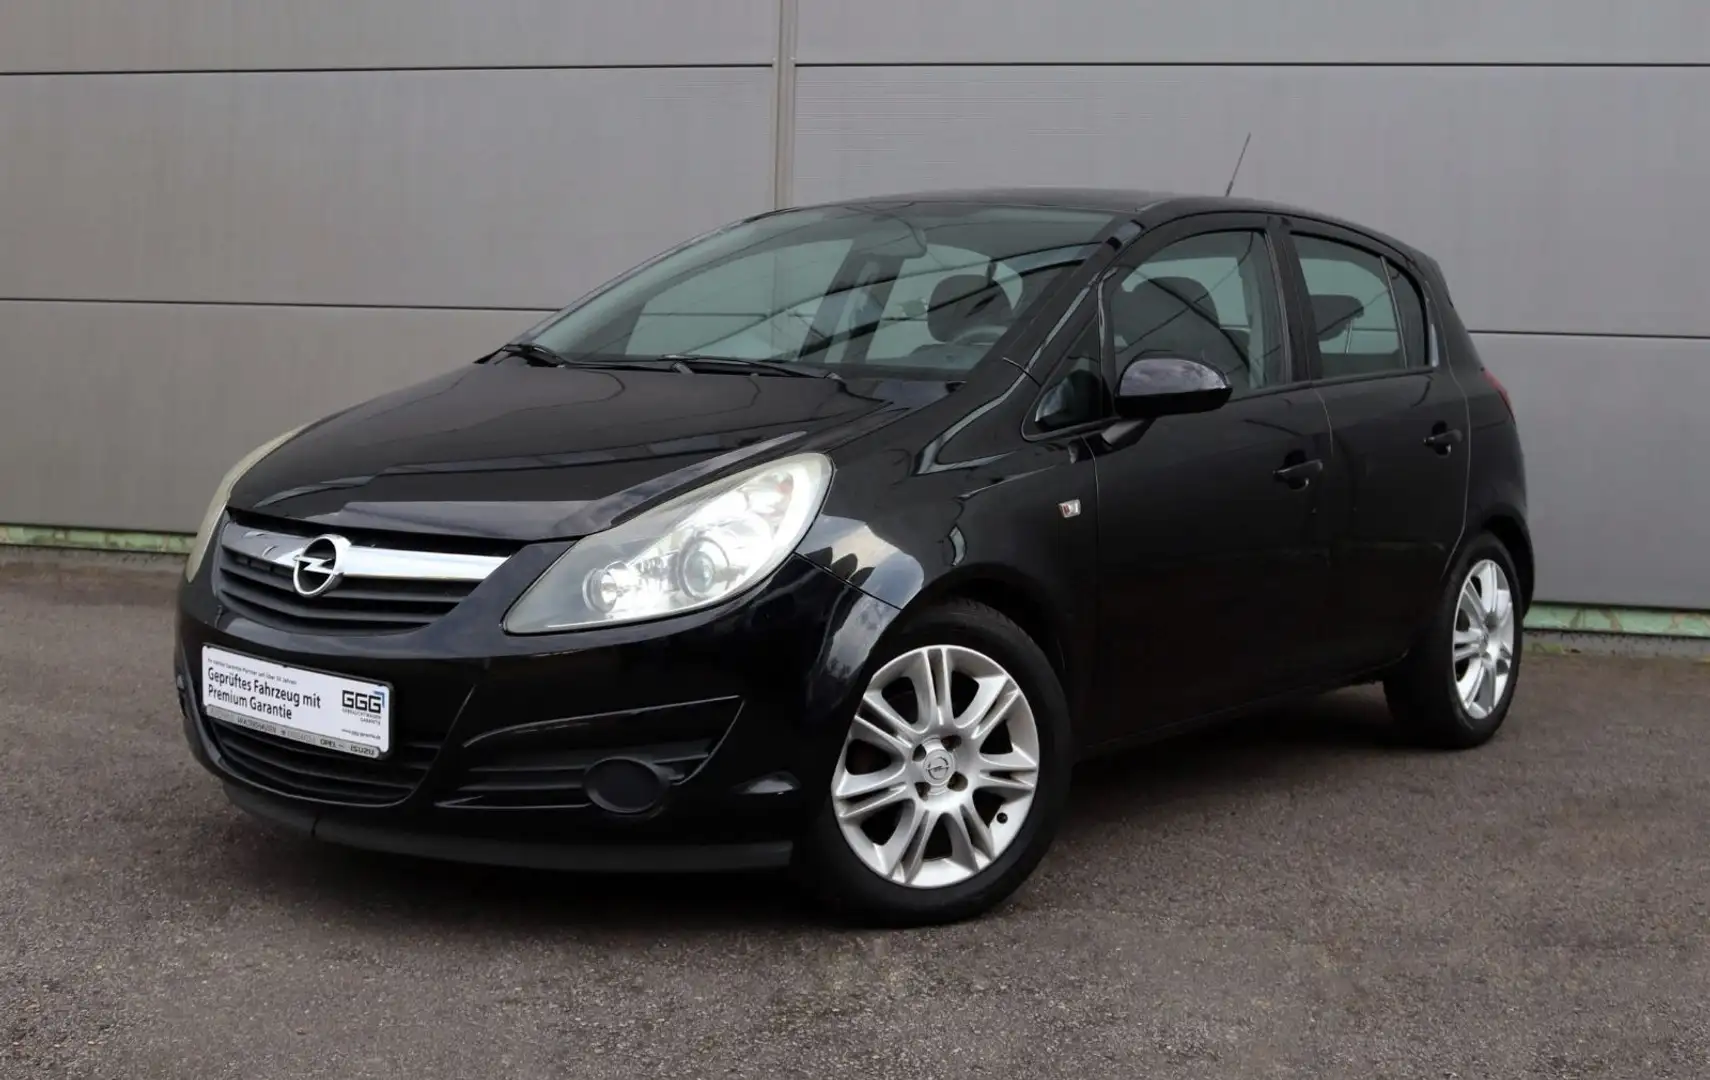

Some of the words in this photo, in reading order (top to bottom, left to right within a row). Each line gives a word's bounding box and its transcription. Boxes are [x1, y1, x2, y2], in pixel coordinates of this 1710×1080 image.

[208, 667, 251, 691] Geprüftes
[254, 679, 300, 707] Fahrzeug
[303, 693, 321, 709] mit
[208, 684, 248, 708] Premium
[249, 696, 292, 719] Garantie
[342, 689, 381, 714] GGG
[350, 744, 375, 756] ISUZU
